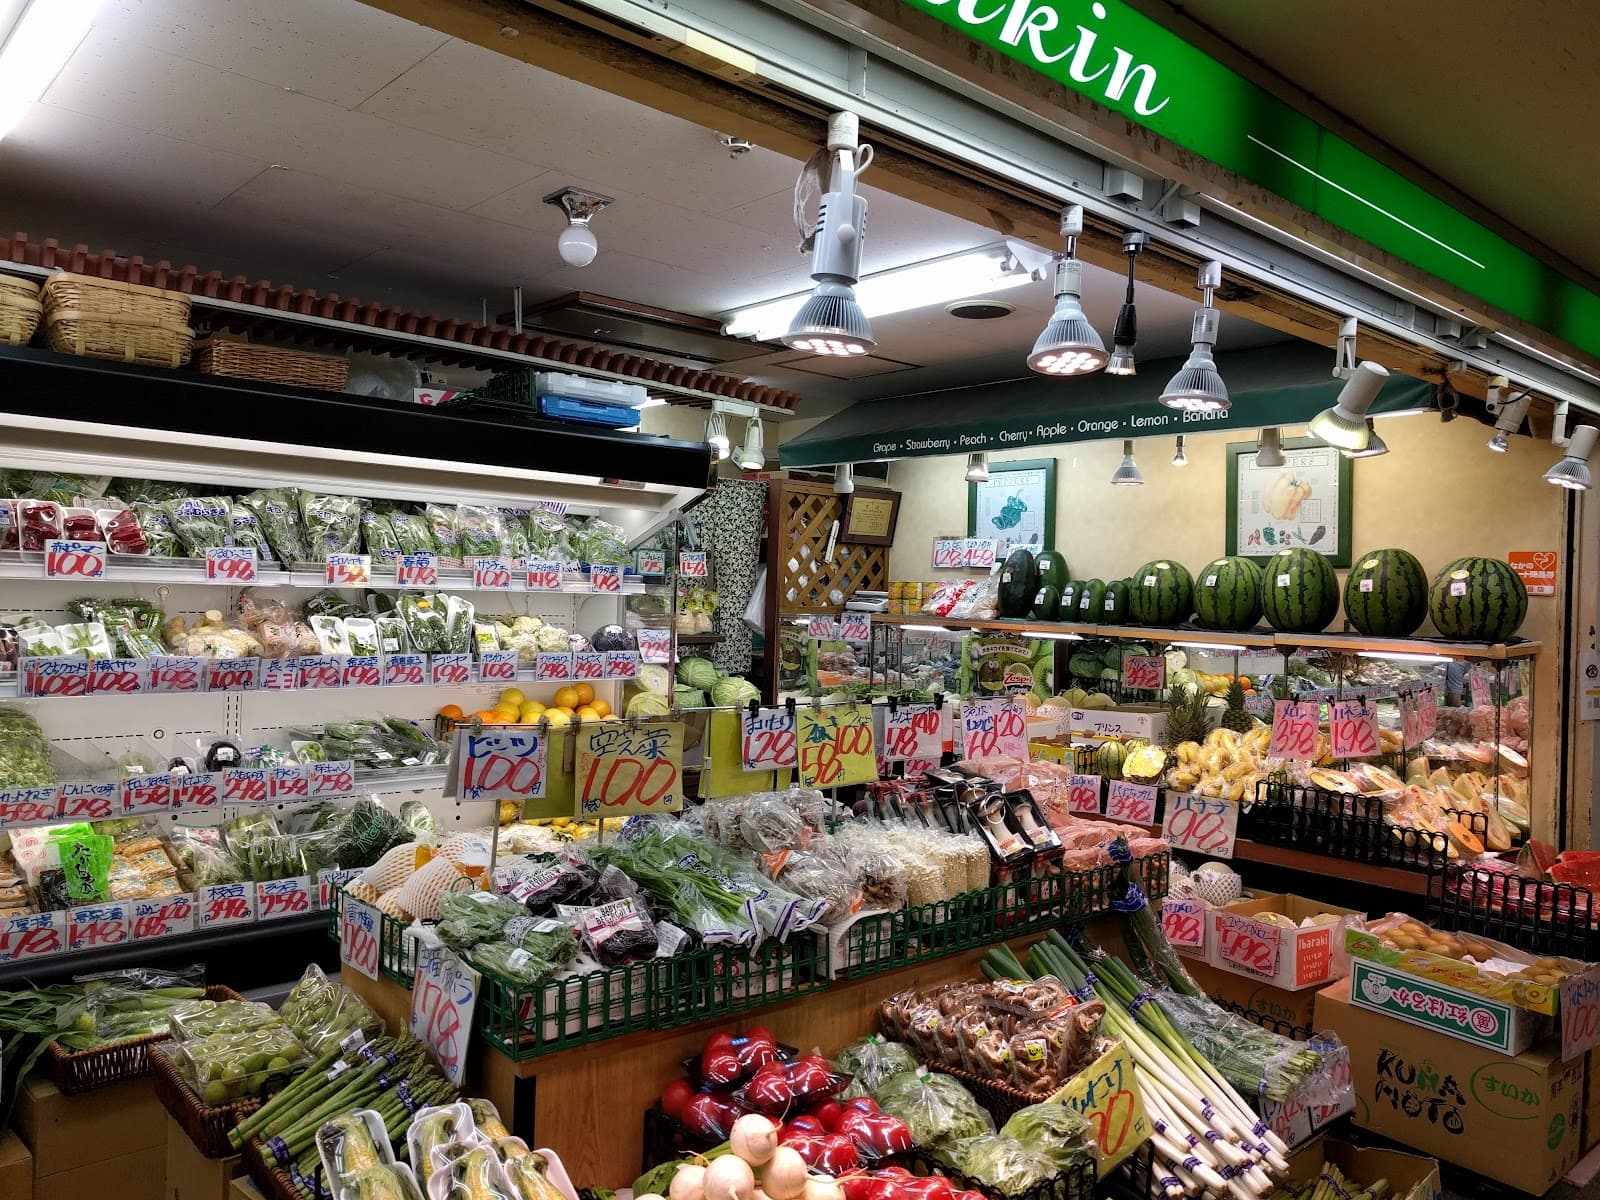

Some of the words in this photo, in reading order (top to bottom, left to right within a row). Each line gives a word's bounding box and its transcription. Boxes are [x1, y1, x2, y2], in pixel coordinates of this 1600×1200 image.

[873, 442, 897, 453] Grape
[906, 437, 951, 451] Strawberry
[960, 434, 987, 446] Peach
[999, 429, 1028, 443] Cherry
[1036, 423, 1067, 438] Apple
[1078, 418, 1119, 434] Orange
[1131, 413, 1169, 428] Lemon
[1182, 409, 1229, 423] Banana
[47, 552, 103, 577] 100
[207, 558, 254, 580] 198
[476, 570, 510, 587] 100
[155, 657, 198, 670] ししとう
[216, 658, 256, 671] 大和芋
[433, 664, 468, 684] 198
[482, 662, 514, 679] 108
[209, 670, 253, 688] 100
[1004, 673, 1033, 685] Zespri
[1281, 703, 1306, 719] メロン
[993, 711, 1025, 738] 120
[1094, 722, 1122, 733] プリンス
[468, 735, 539, 758] ビーツ
[836, 724, 873, 756] 100
[1277, 719, 1314, 754] 358
[1332, 720, 1376, 753] 198
[743, 730, 797, 766] 128
[464, 754, 541, 794] 100
[582, 756, 677, 806] 100
[63, 783, 115, 796] にんにくの芽
[1070, 787, 1098, 811] 98
[60, 797, 112, 818] 128
[1174, 796, 1230, 815] バナナ
[1168, 808, 1229, 850] 98
[207, 883, 245, 898] 枝豆
[1299, 934, 1328, 949] Ibaraki
[1392, 988, 1469, 1024] 紅はるか
[1481, 1074, 1541, 1106] すいか
